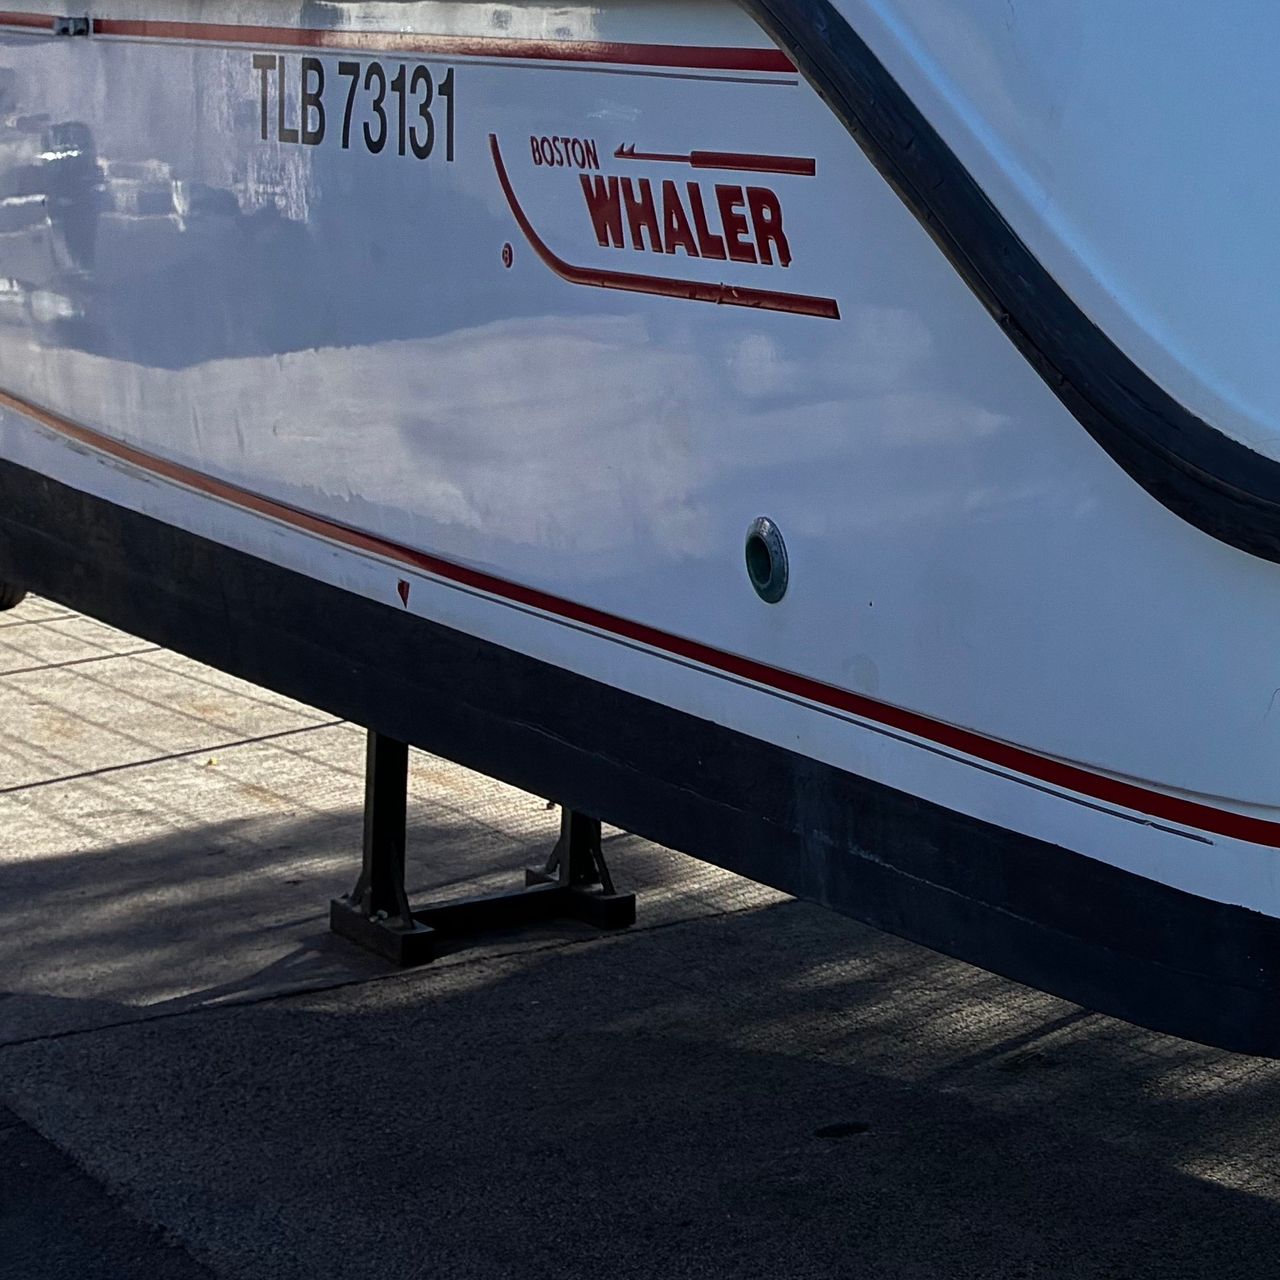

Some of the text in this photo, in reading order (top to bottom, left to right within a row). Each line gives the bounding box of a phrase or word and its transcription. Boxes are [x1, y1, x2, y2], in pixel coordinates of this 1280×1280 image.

[252, 53, 454, 162] TLB 73131
[530, 135, 600, 170] BOSTON
[579, 173, 792, 268] WHALER
